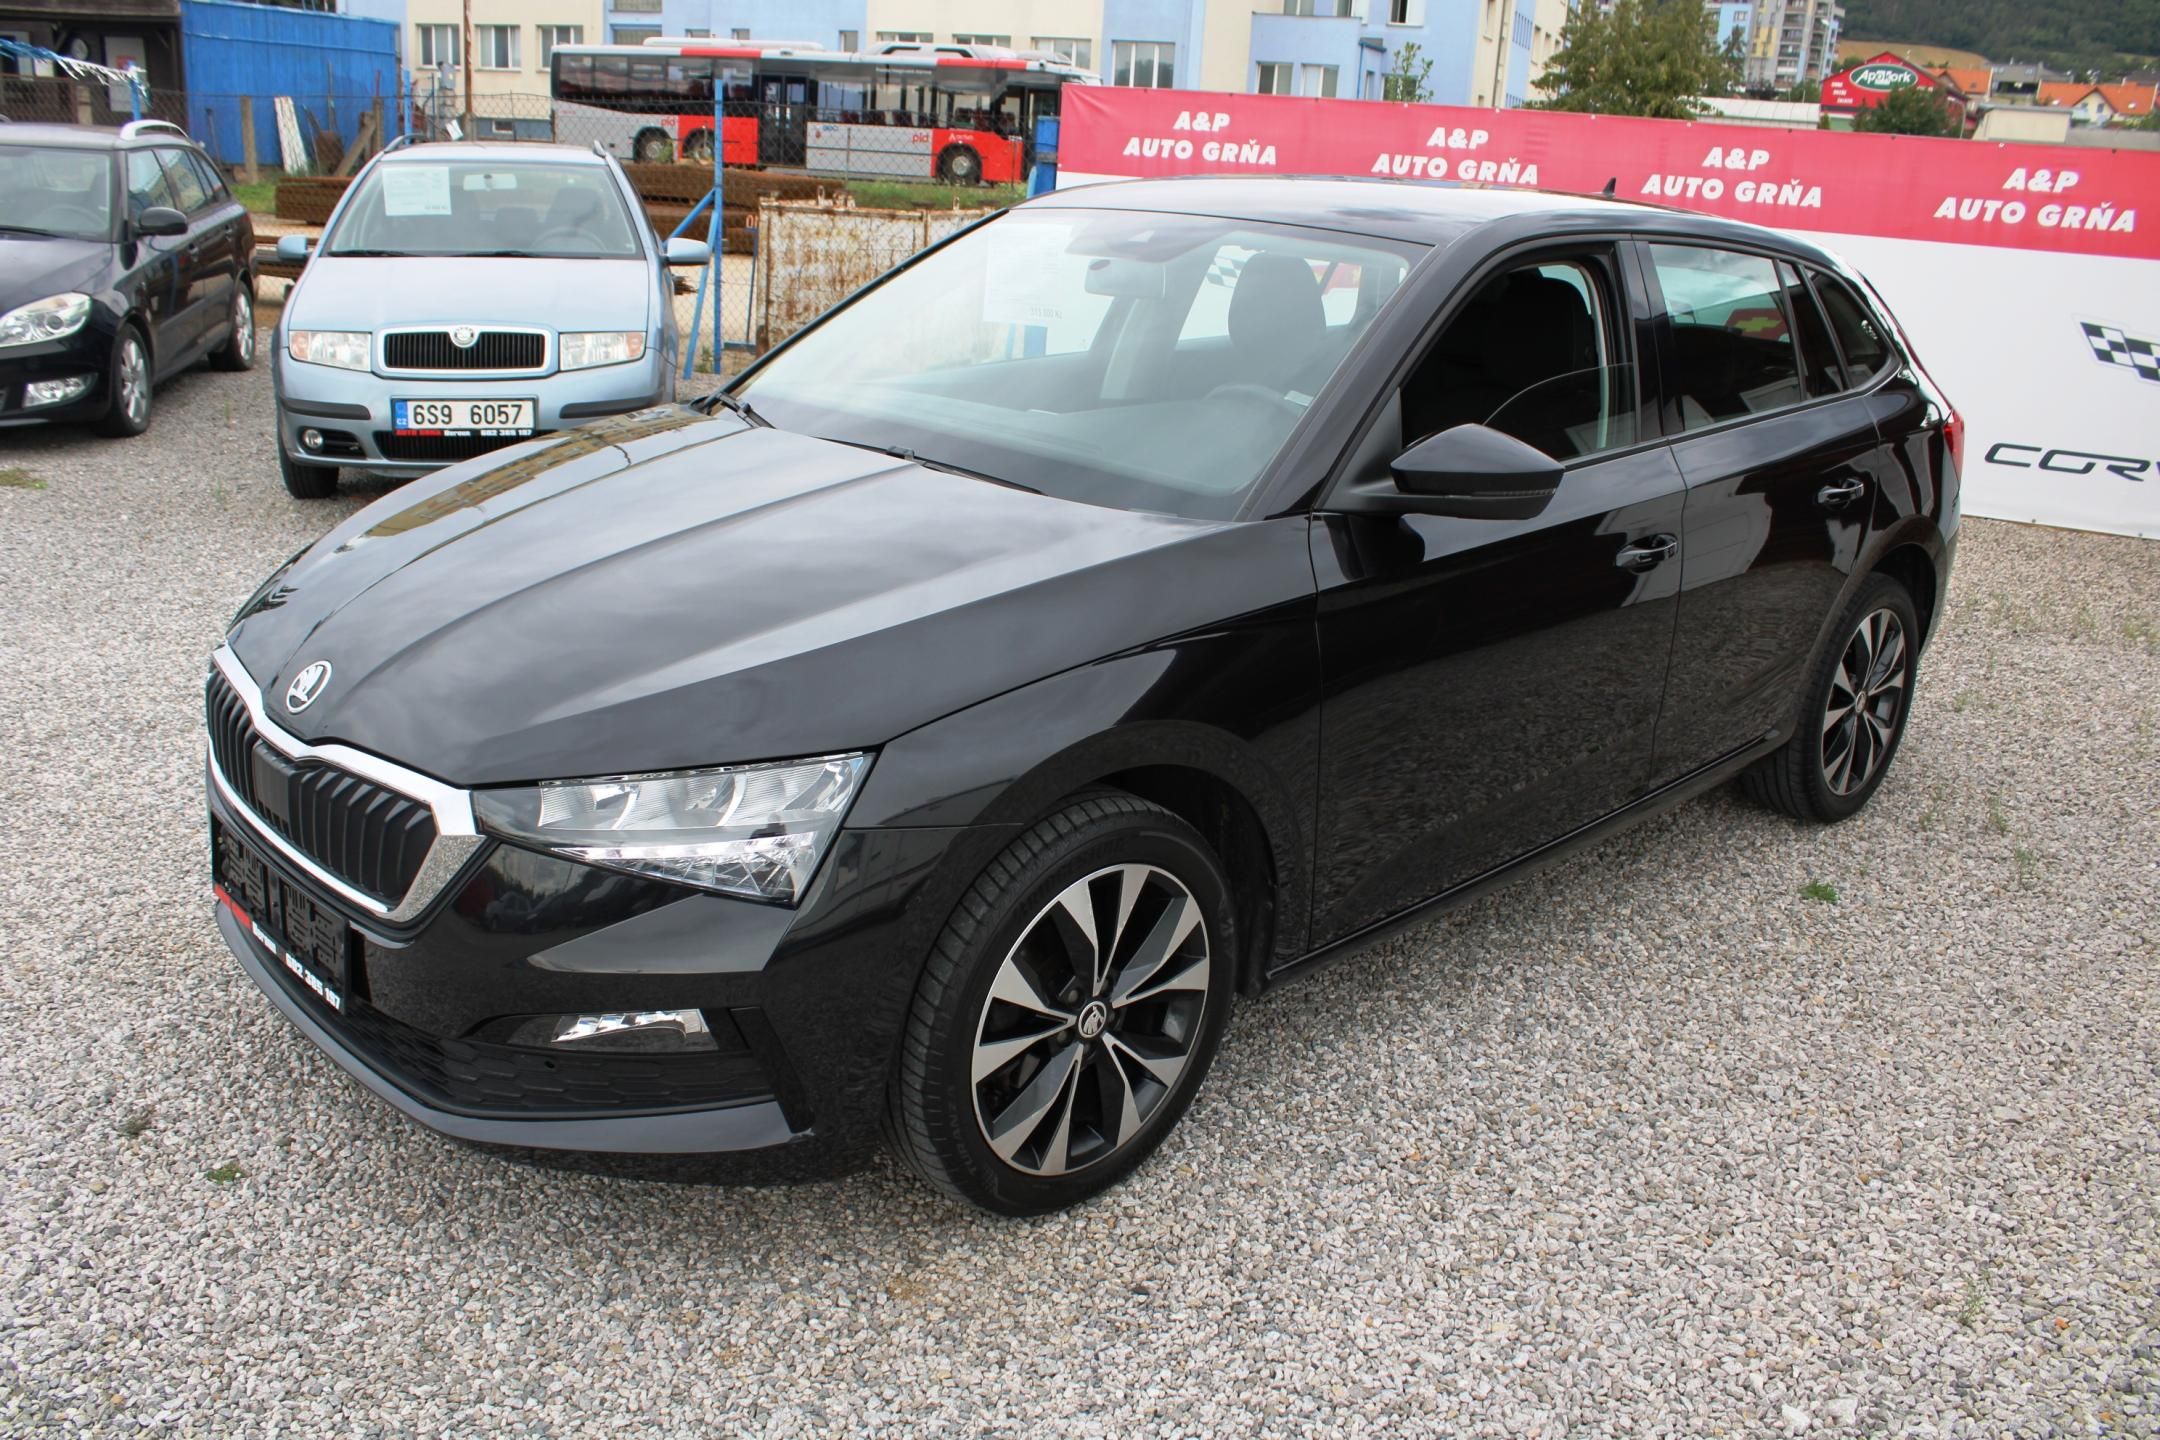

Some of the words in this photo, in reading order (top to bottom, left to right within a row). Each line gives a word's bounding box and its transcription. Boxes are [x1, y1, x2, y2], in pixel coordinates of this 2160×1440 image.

[1173, 111, 1230, 132] A&P
[912, 133, 929, 144] pid
[1123, 137, 1194, 160] AUTO
[1202, 139, 1277, 165] GRŇA
[1426, 127, 1489, 150] A&P
[1371, 153, 1448, 178] AUTO
[1457, 157, 1538, 185] GRŇA
[1702, 147, 1770, 171] A&P
[1641, 174, 1724, 200] AUTO
[1734, 179, 1822, 208] GRŇA
[2002, 168, 2079, 193] A&P
[1934, 197, 2026, 224] AUTO
[2037, 202, 2134, 232] GRŇA
[413, 404, 452, 425] 6S9
[470, 404, 522, 425] 6057
[1985, 442, 2160, 482] COR
